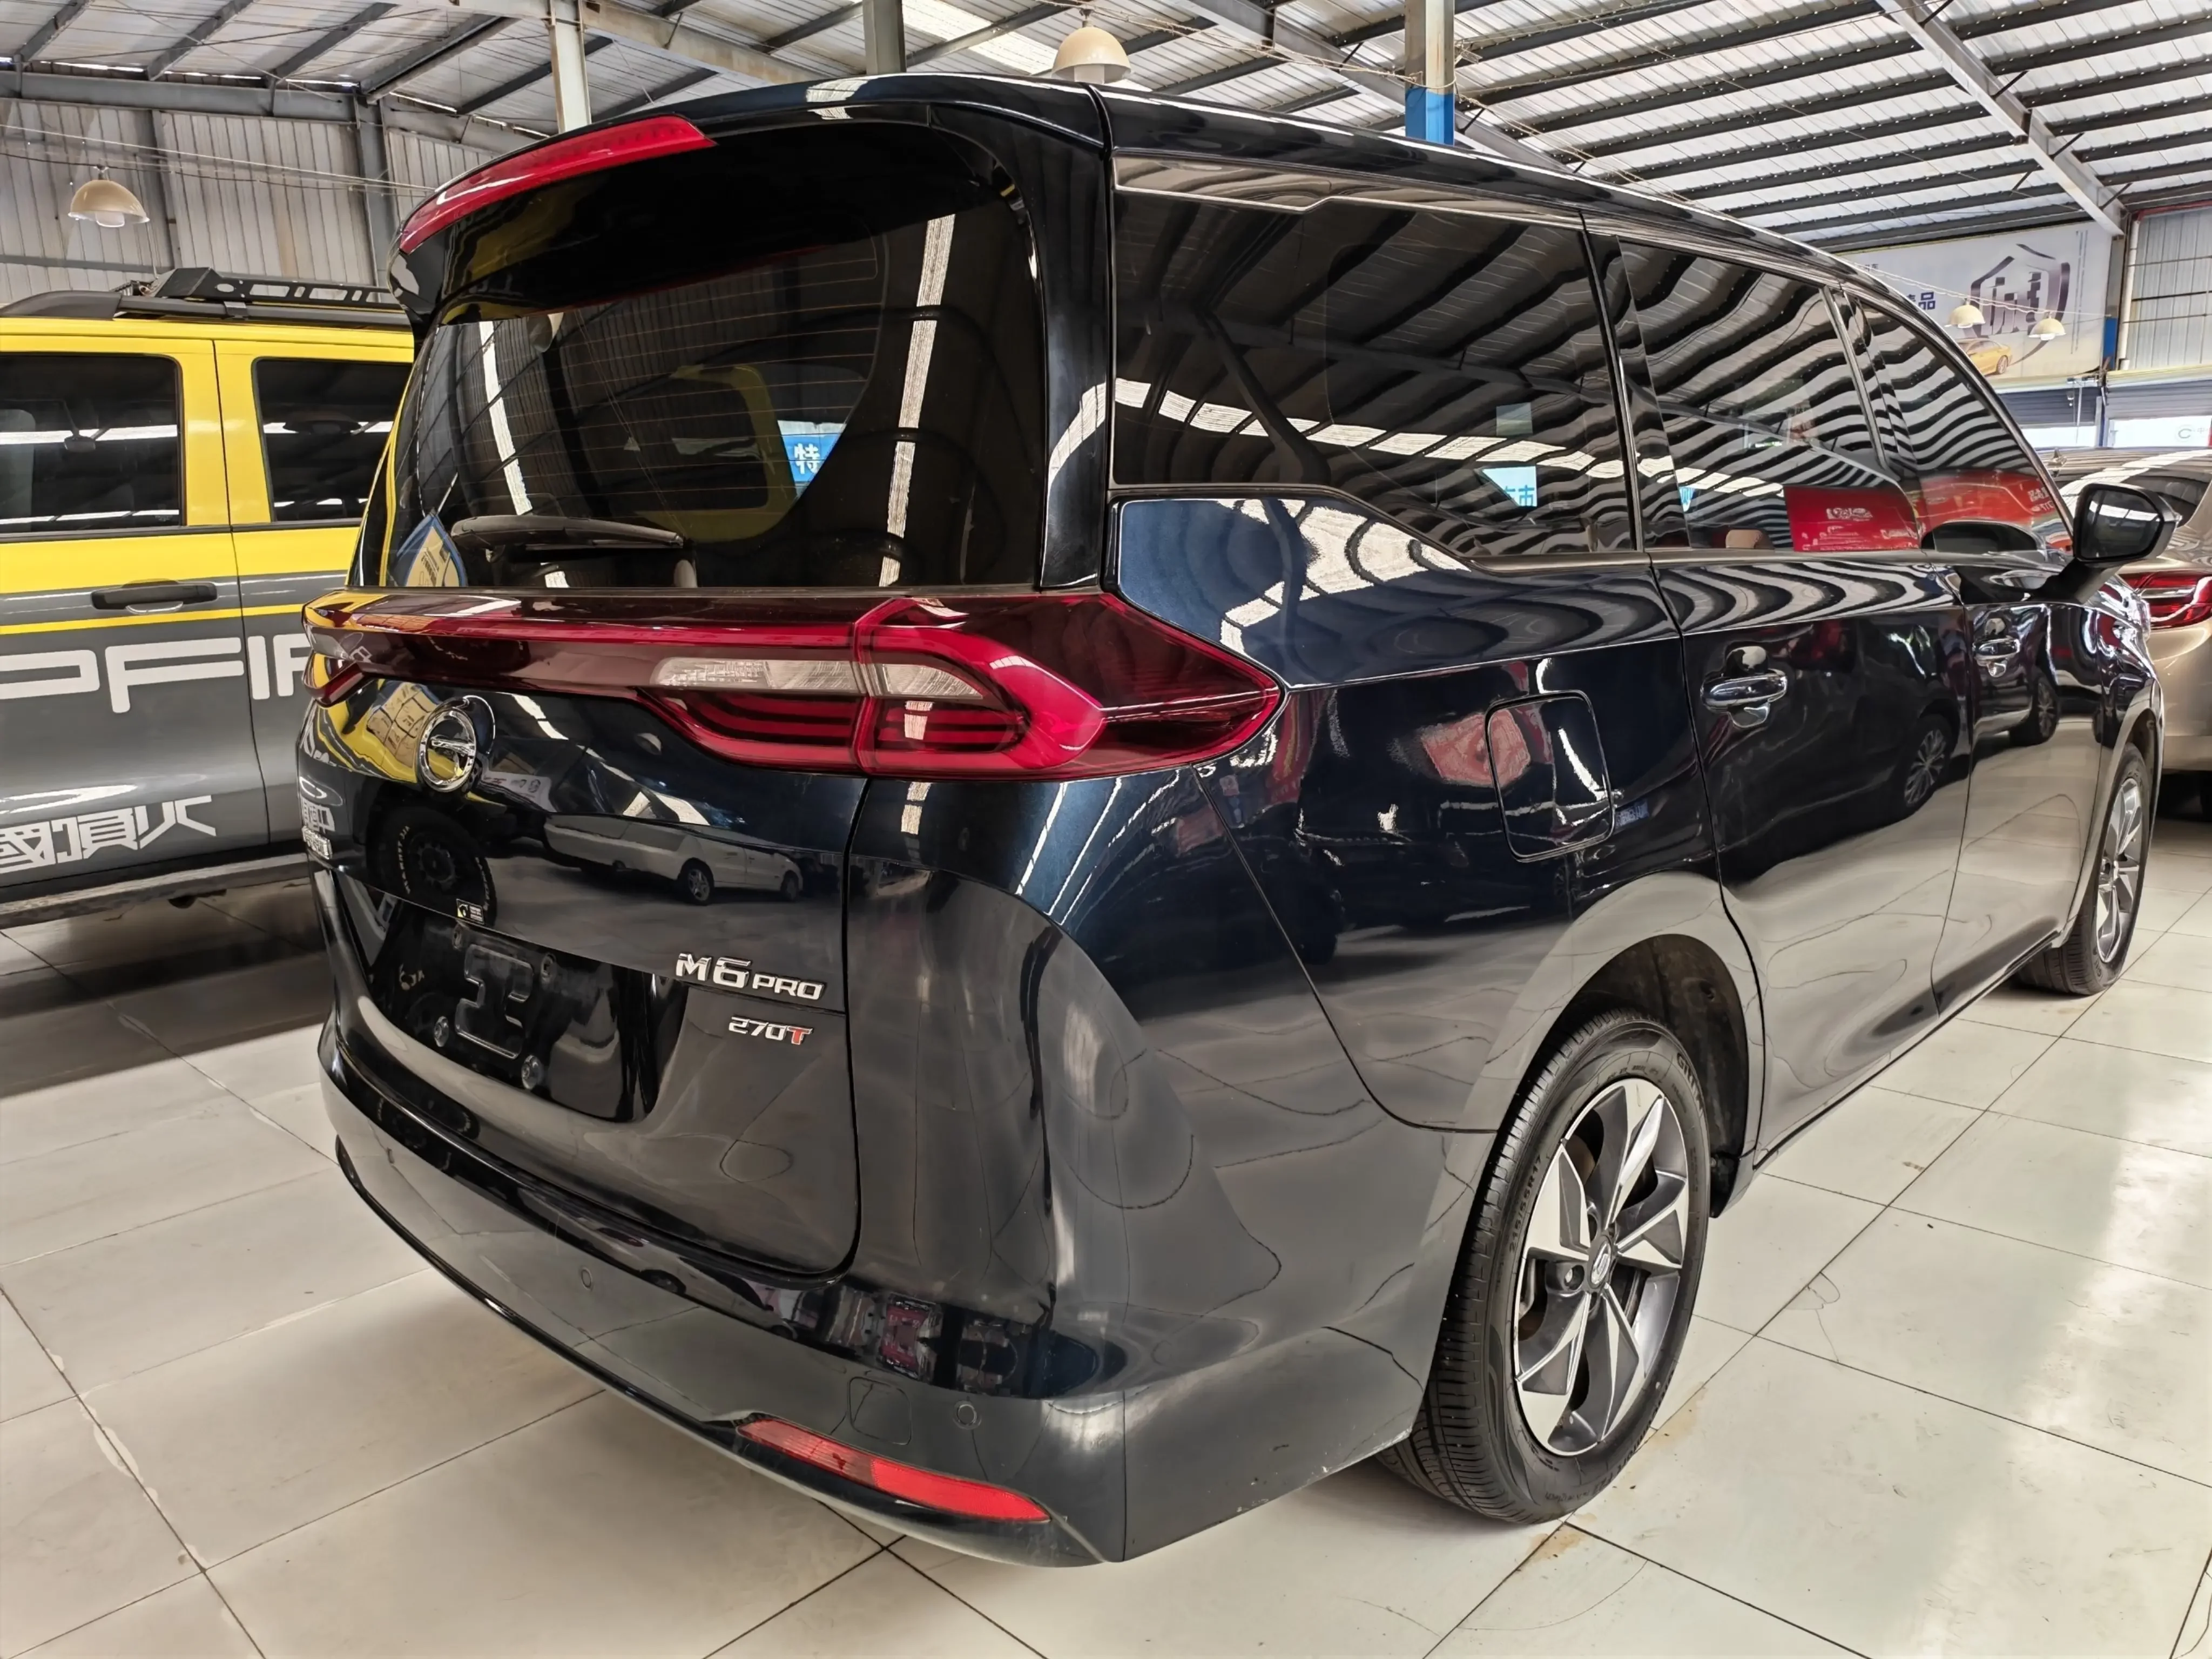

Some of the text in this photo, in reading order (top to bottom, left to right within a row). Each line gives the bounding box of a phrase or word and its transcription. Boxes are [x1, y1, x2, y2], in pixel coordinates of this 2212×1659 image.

[793, 442, 820, 474] 特
[676, 953, 825, 1000] M6 PRO
[729, 1016, 813, 1045] 270T
